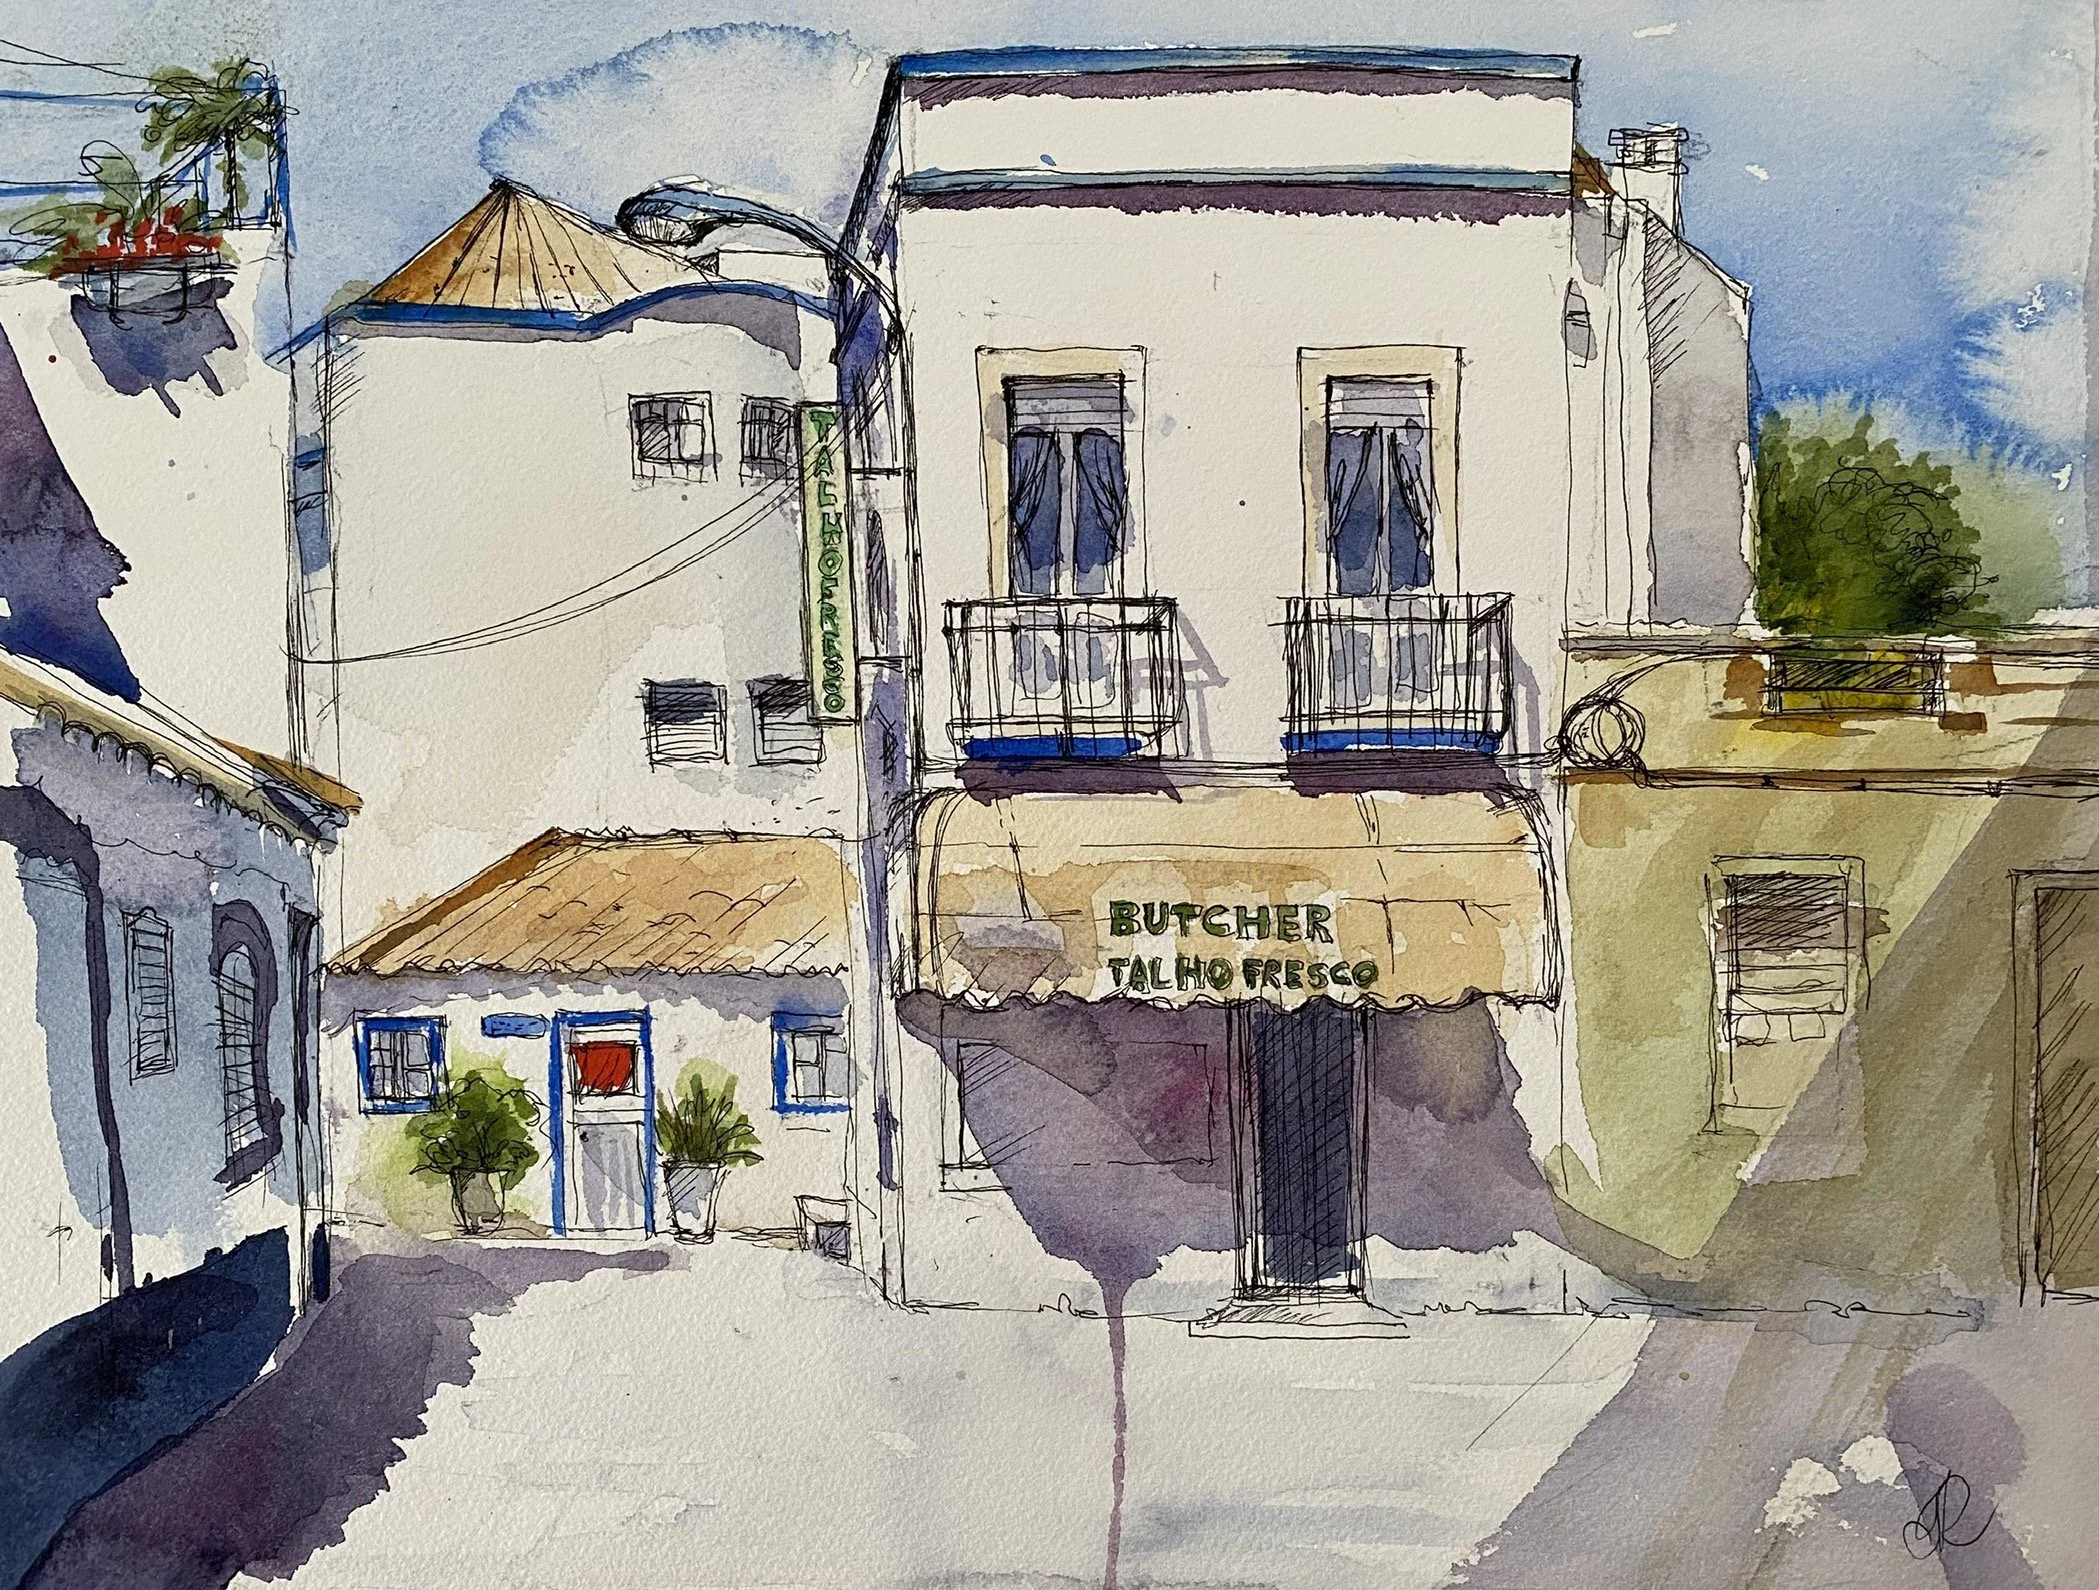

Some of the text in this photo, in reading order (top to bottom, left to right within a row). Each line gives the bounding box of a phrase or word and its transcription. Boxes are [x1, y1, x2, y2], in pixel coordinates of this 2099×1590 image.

[1108, 900, 1334, 944] BUTCHER
[1107, 953, 1379, 994] TALHO FRESCO
